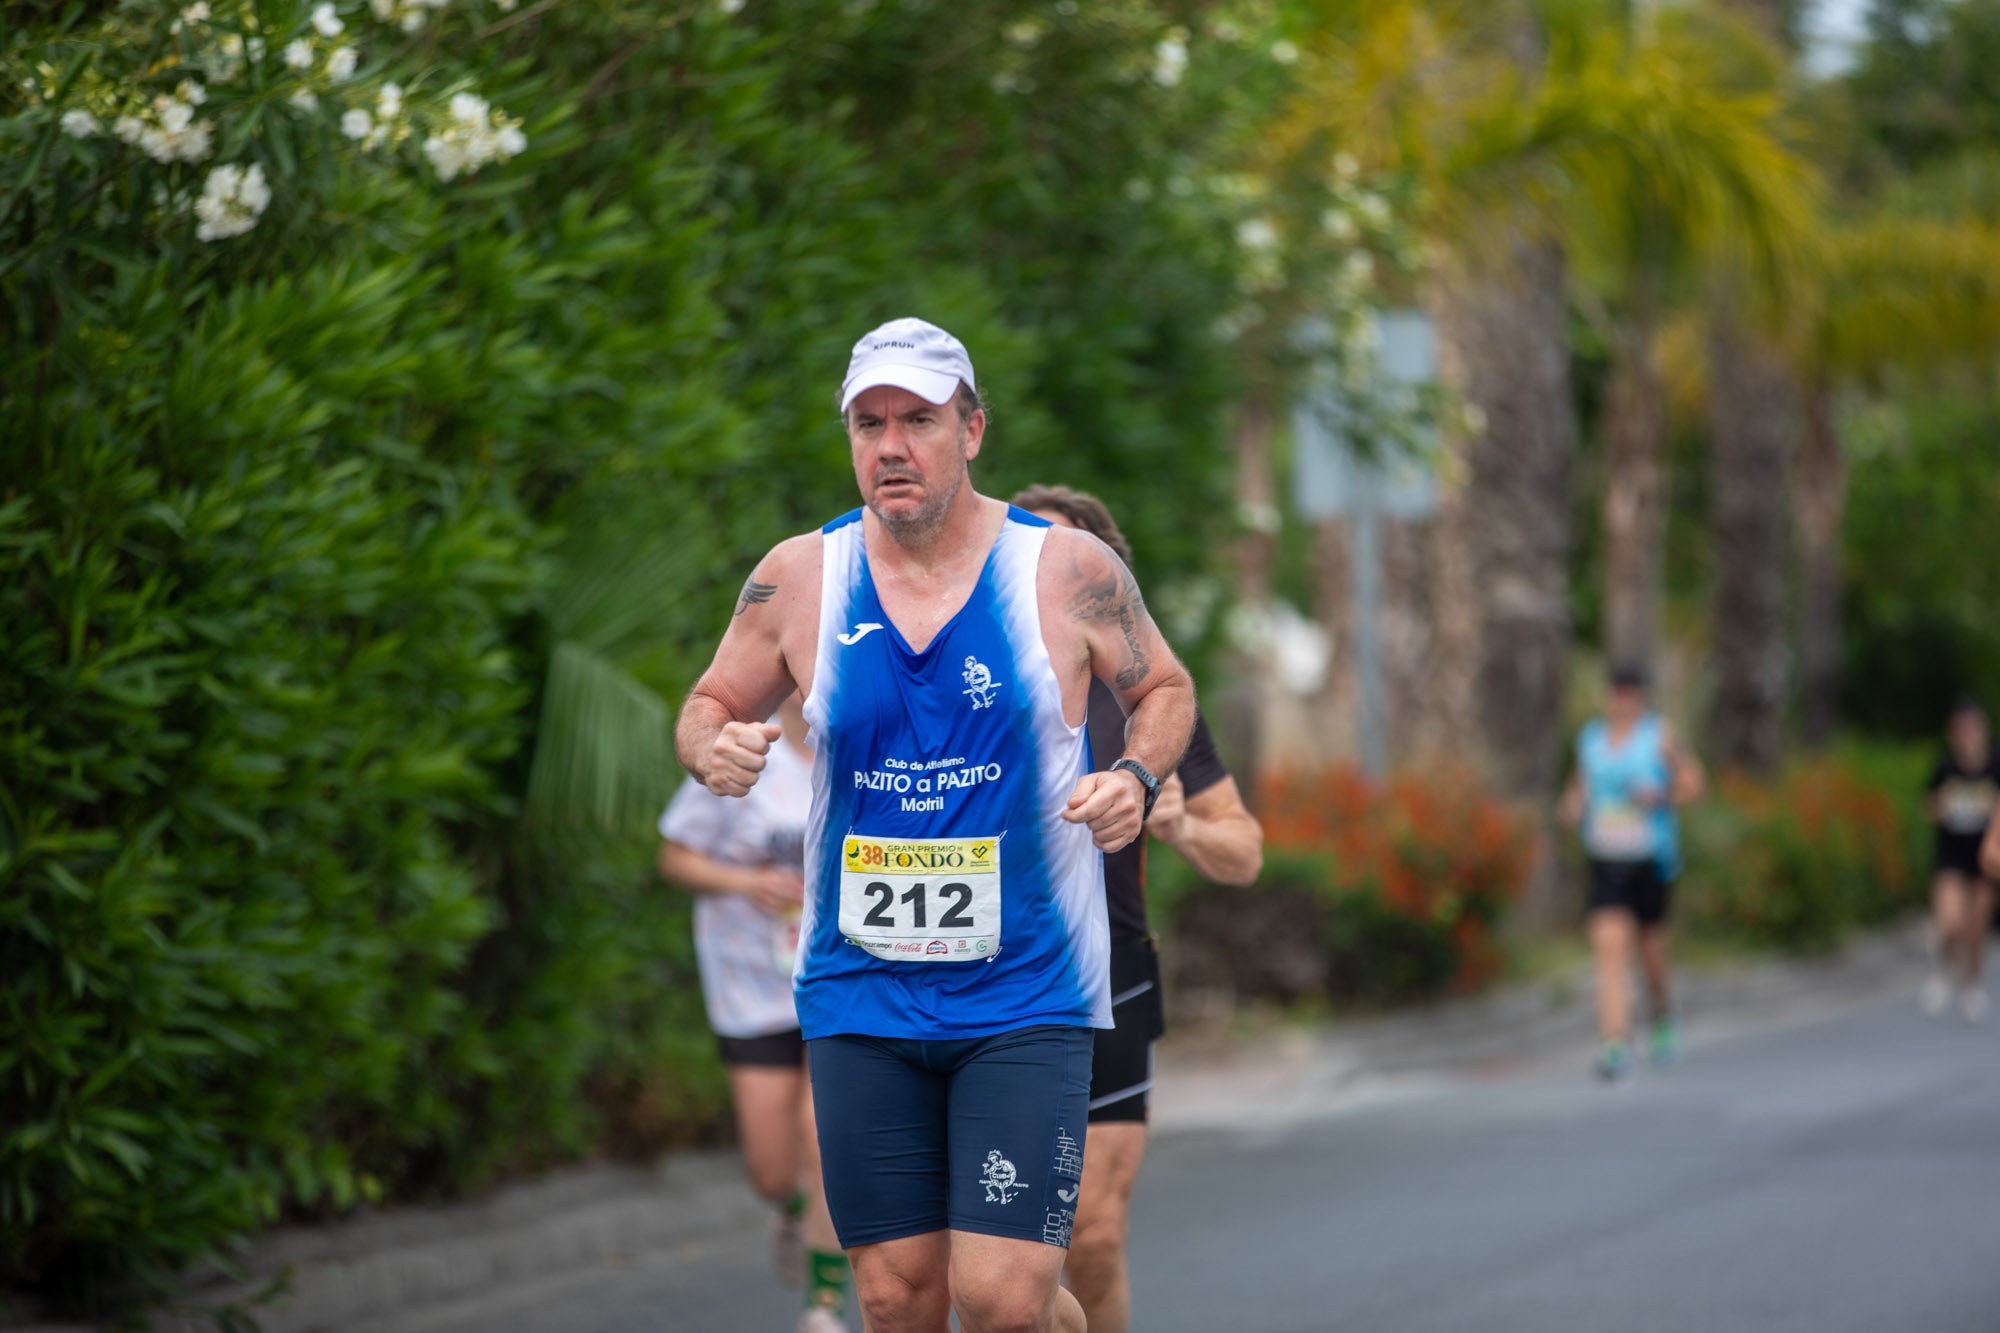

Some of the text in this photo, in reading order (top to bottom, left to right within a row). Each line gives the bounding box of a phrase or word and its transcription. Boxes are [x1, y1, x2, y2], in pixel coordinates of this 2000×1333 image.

[873, 341, 915, 351] KIPRUN
[885, 757, 908, 770] Club
[909, 761, 924, 771] de
[853, 762, 1002, 793] PAZITO a PAZITO
[901, 796, 944, 812] Motril
[861, 844, 884, 866] 38
[887, 844, 916, 853] GRAN
[917, 845, 957, 853] PREMIO
[884, 852, 964, 868] FONDO
[863, 881, 974, 928] 212
